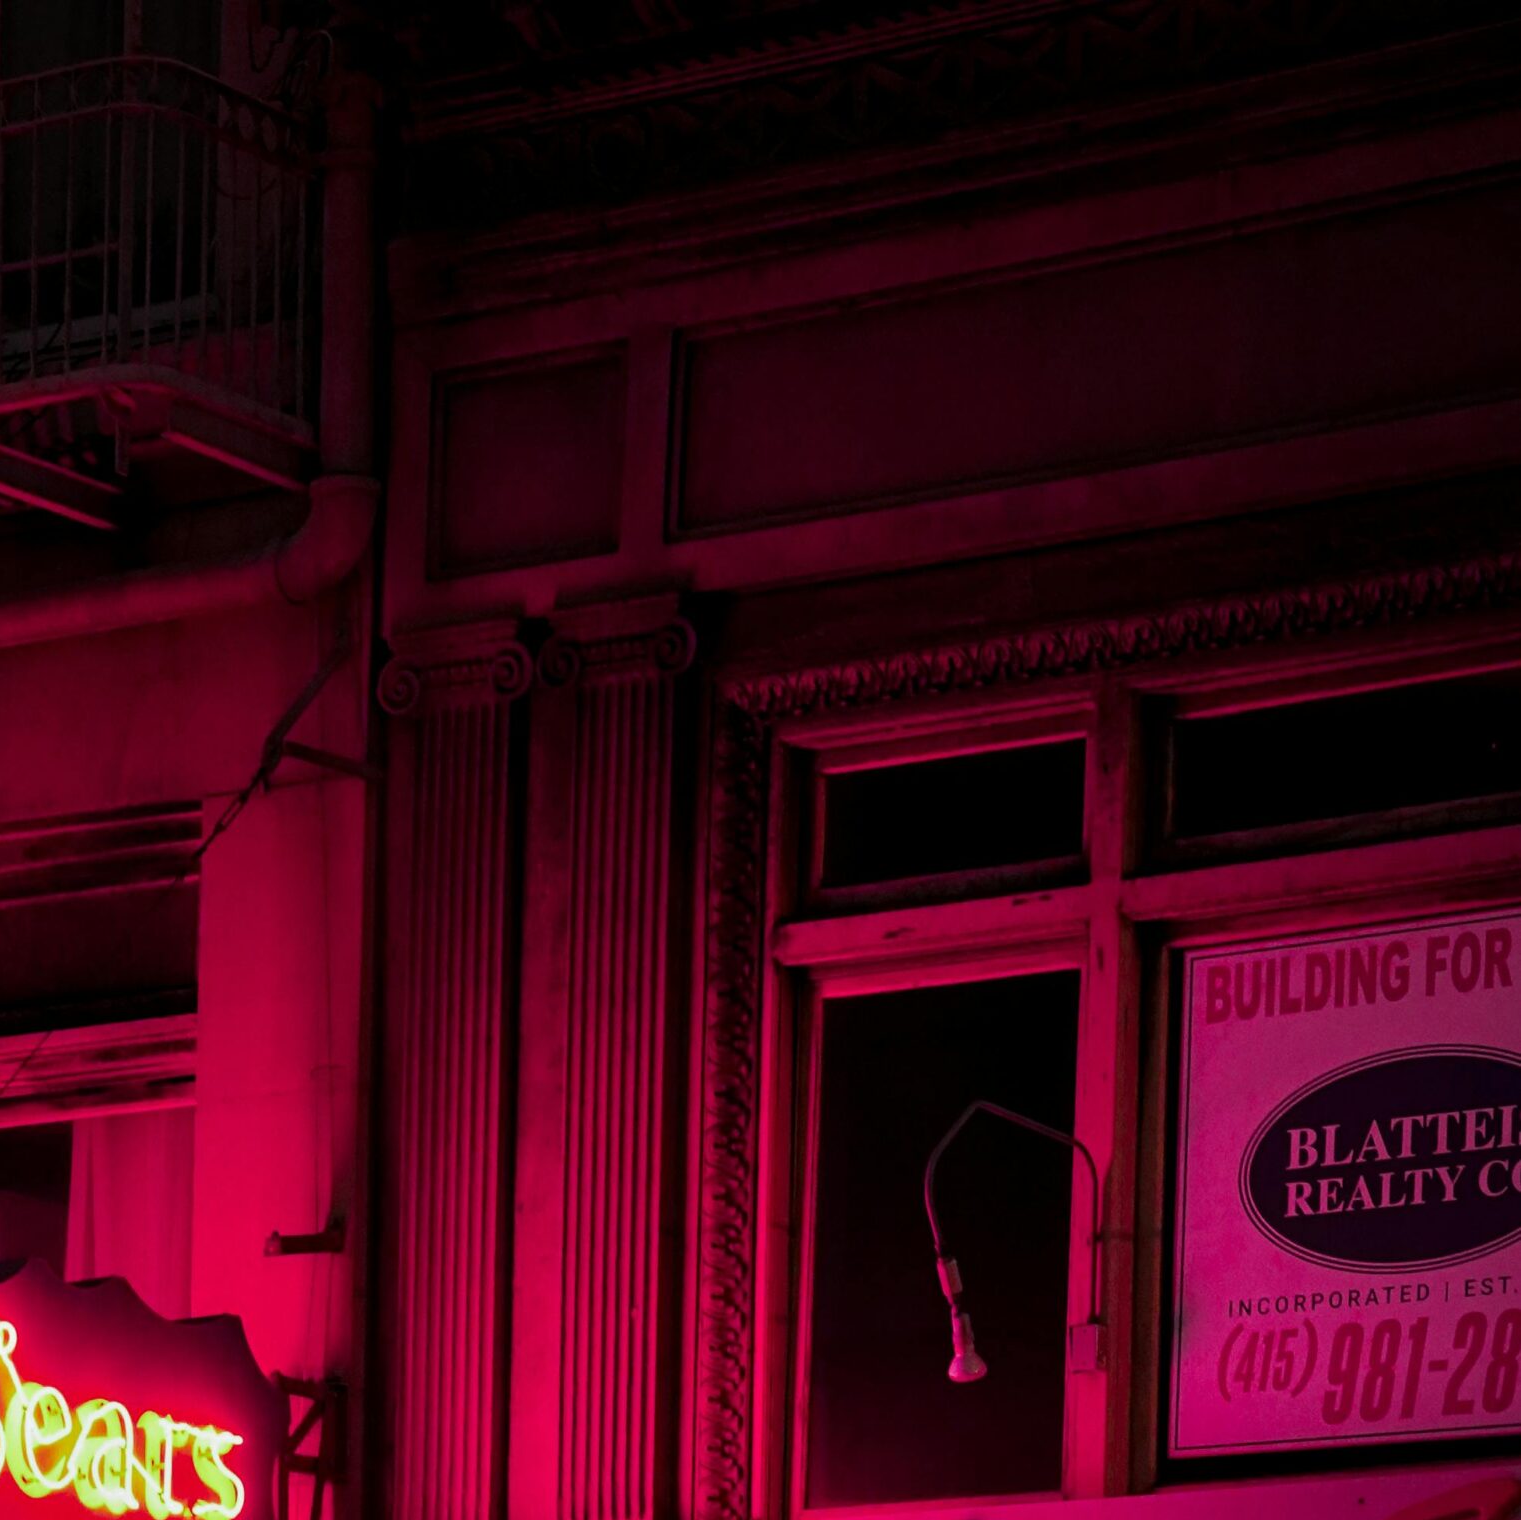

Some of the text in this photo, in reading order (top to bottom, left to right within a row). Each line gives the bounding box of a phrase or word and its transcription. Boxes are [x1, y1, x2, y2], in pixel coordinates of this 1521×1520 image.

[1205, 927, 1513, 1024] BUILDING FOR
[1285, 1104, 1521, 1171] BLATTEI
[1283, 1157, 1521, 1219] REALTY C
[1229, 1275, 1520, 1318] INCORPORATED EST.
[1217, 1317, 1319, 1402] (415)
